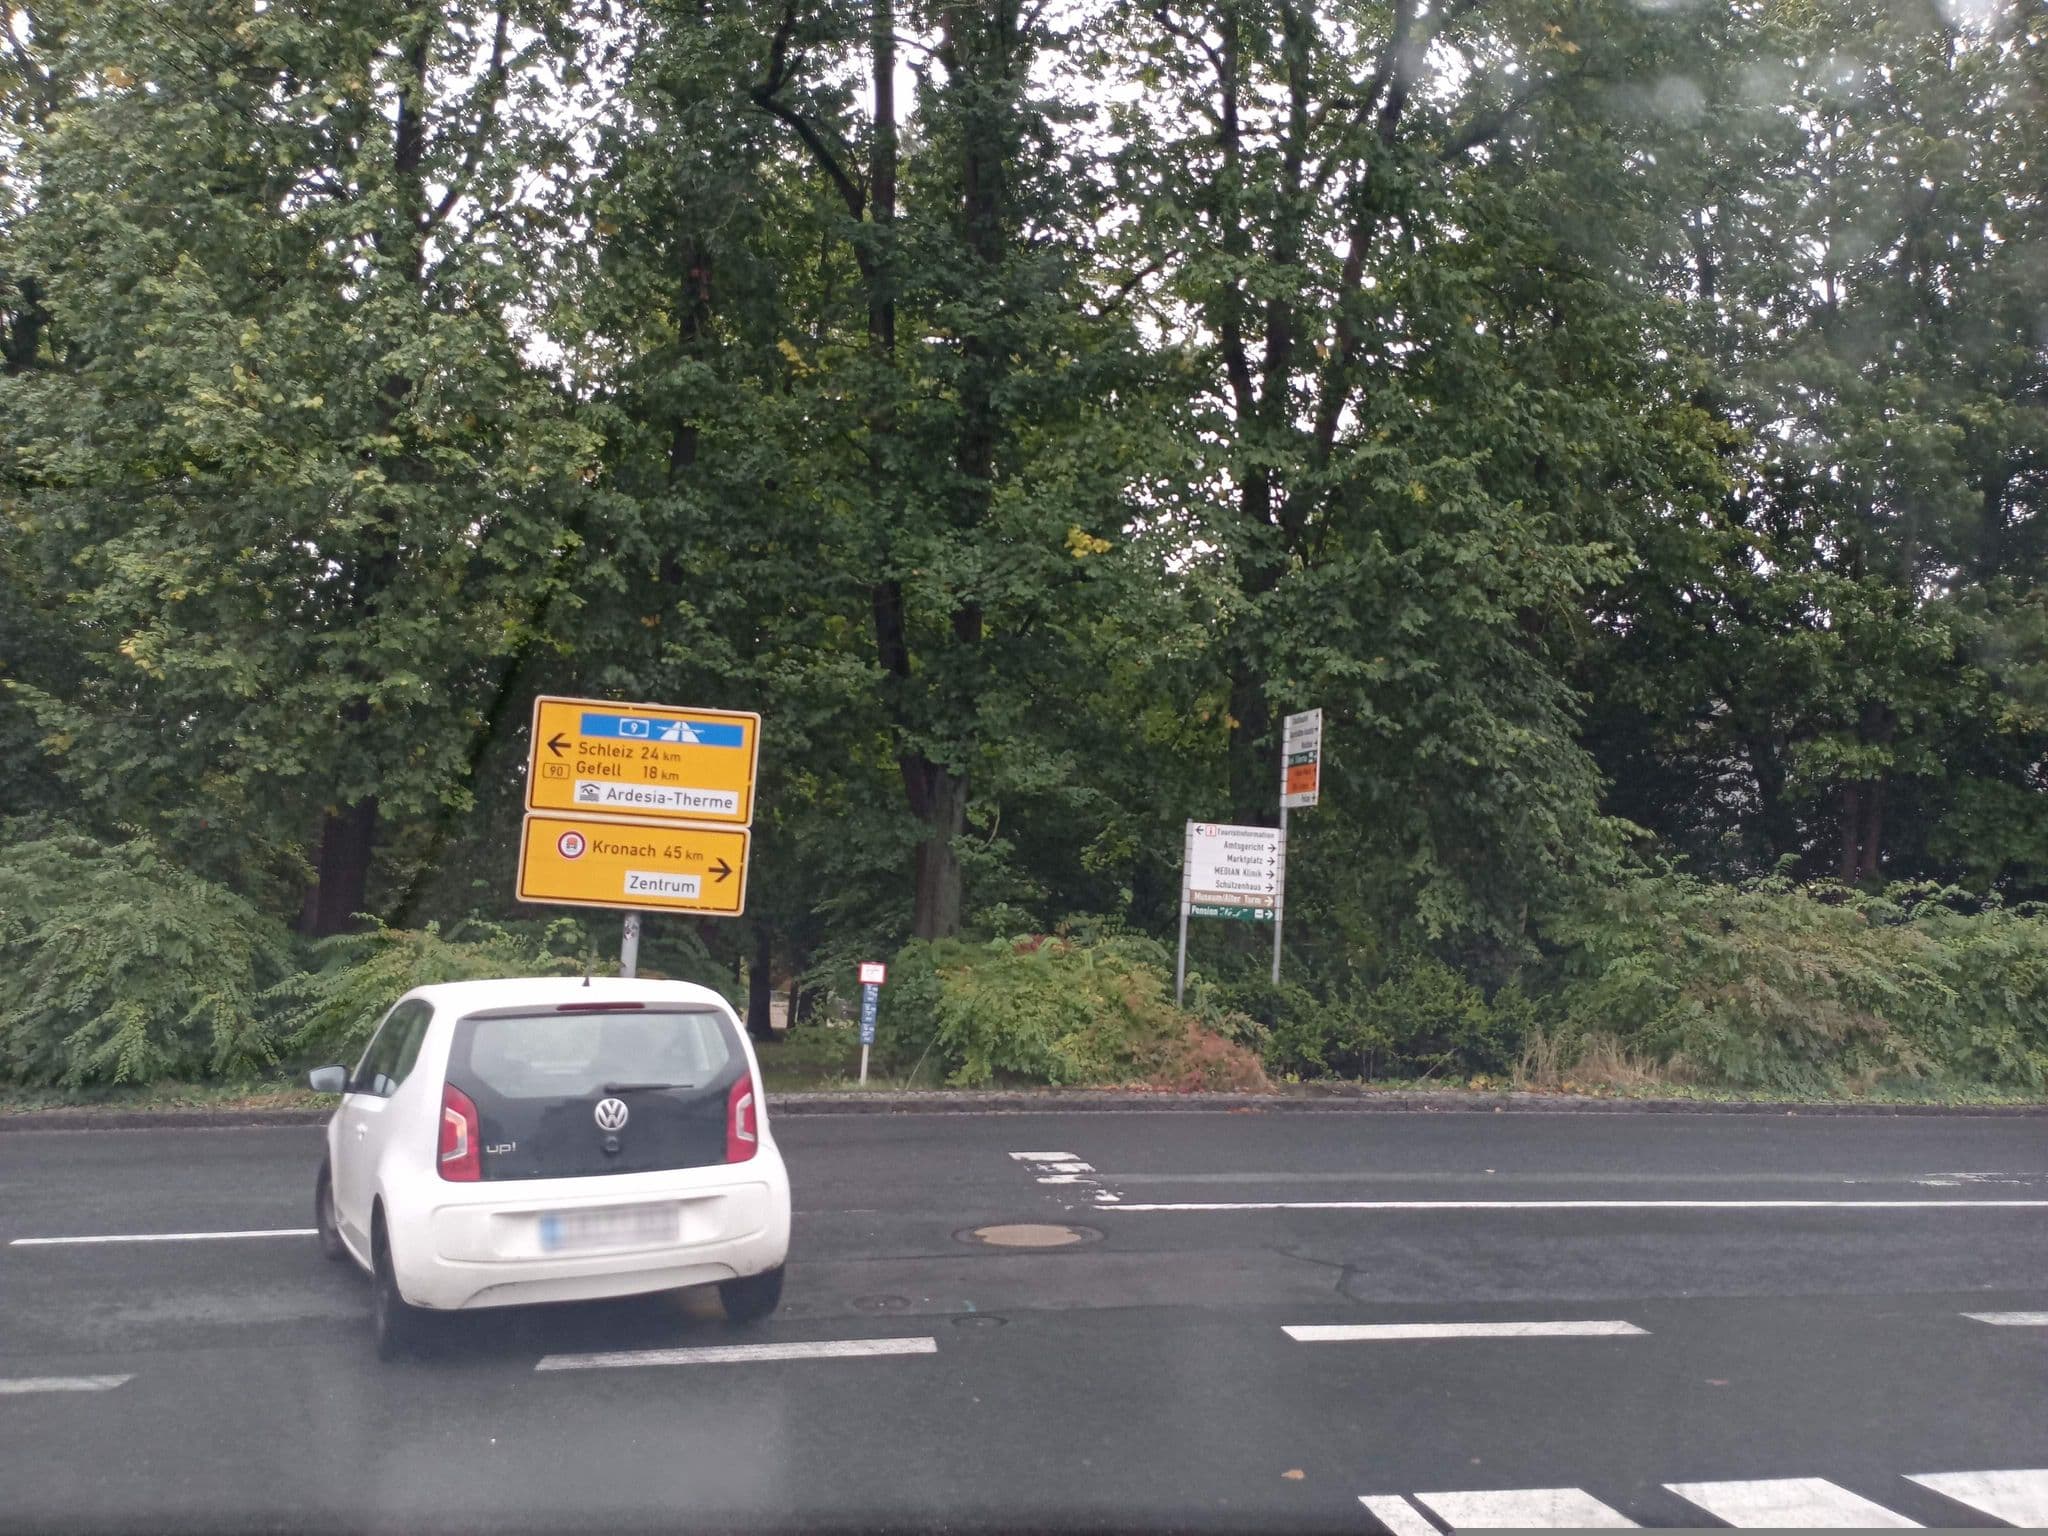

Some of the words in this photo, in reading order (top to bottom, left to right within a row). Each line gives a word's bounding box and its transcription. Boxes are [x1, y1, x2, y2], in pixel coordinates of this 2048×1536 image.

[630, 723, 638, 732] 9
[578, 742, 633, 759] Schleiz
[641, 747, 659, 760] 24
[662, 751, 681, 762] km
[549, 766, 564, 777] 90
[576, 761, 622, 777] Gefell
[643, 766, 658, 779] 18
[661, 770, 680, 781] km
[606, 787, 733, 809] Ardesia-Therme
[592, 840, 656, 858] Kronach
[663, 846, 683, 859] 45
[685, 850, 704, 861] km
[1224, 840, 1264, 851] Amtsgericht
[1227, 854, 1263, 865] Marktplatz
[1214, 866, 1240, 876] MEDIAN
[1243, 868, 1262, 877] Klinik
[629, 875, 695, 894] Zentrum
[486, 1140, 517, 1155] up!
